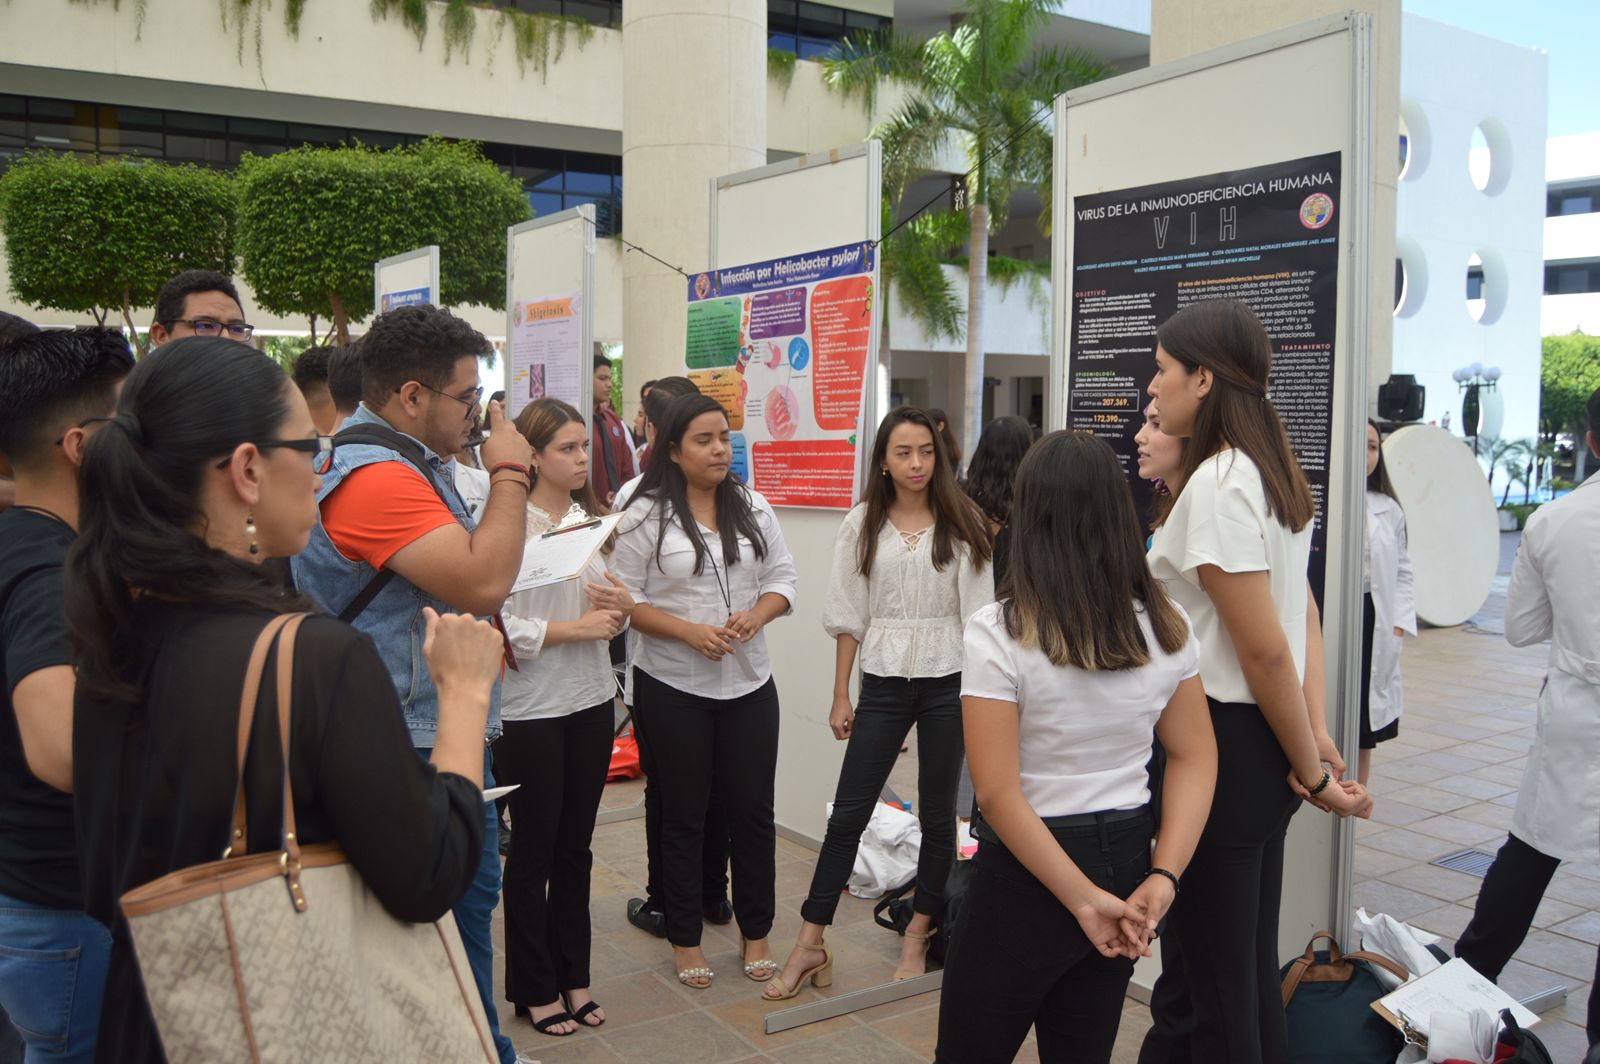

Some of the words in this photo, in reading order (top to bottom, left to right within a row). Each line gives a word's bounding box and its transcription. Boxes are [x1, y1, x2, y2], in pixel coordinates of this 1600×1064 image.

[1077, 207, 1105, 221] VIRUS
[1108, 204, 1122, 217] DE
[1124, 202, 1138, 215] LA
[1141, 183, 1265, 212] INMUNODEFICIENCIA
[1269, 172, 1333, 192] HUMANA
[720, 268, 756, 284] Infección
[757, 267, 772, 281] por
[774, 255, 830, 275] Helicobacter
[832, 246, 860, 268] pylori
